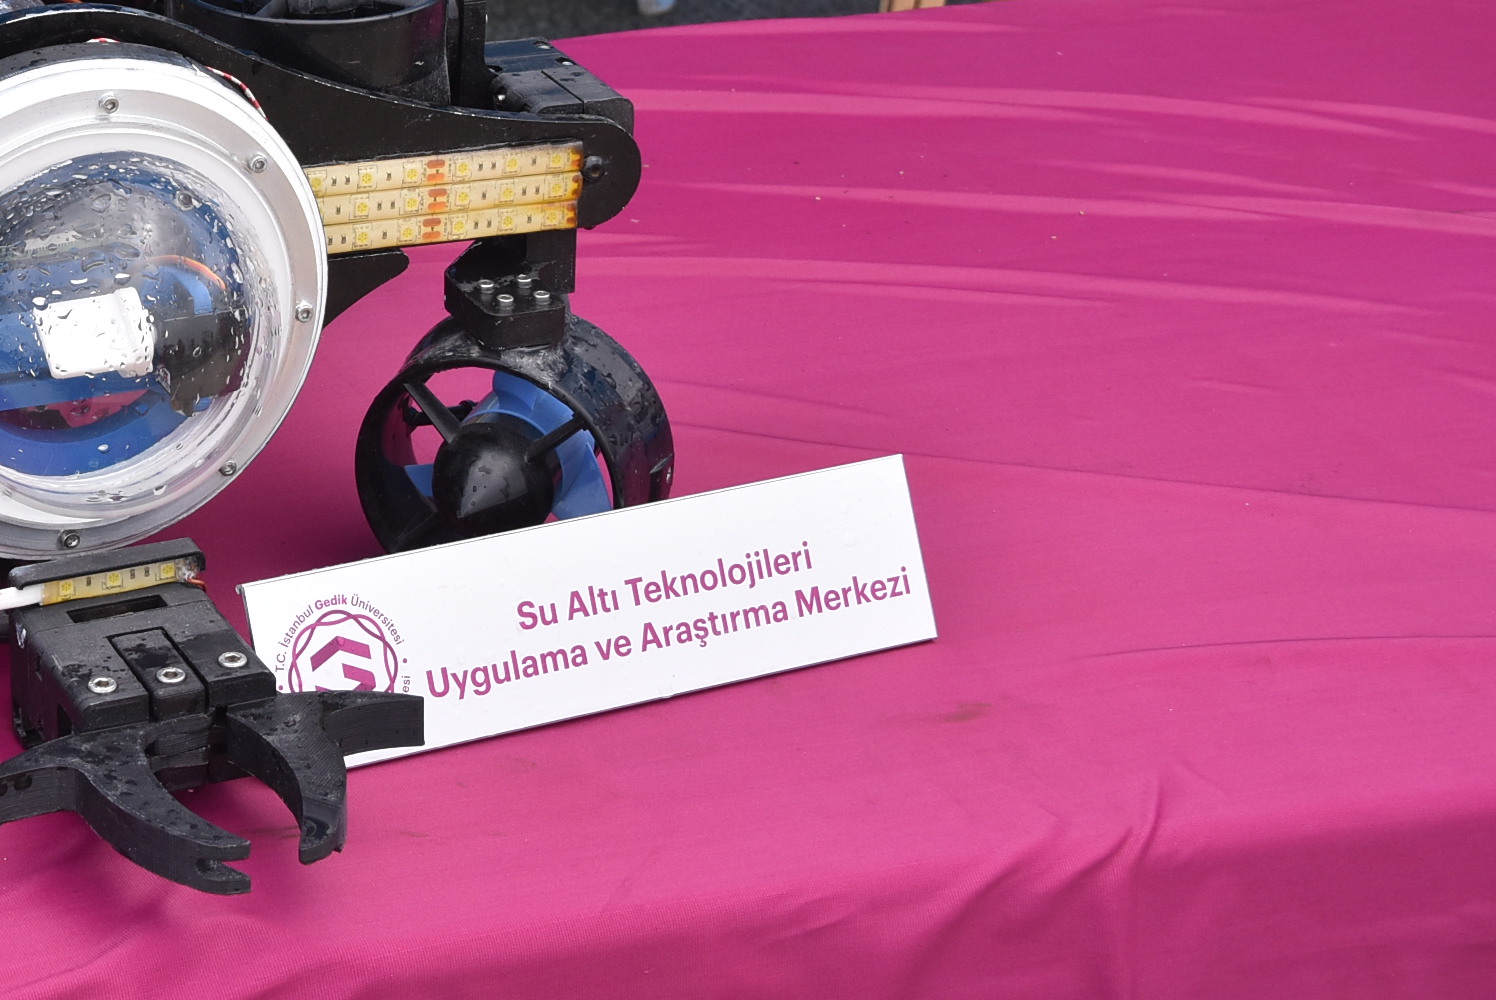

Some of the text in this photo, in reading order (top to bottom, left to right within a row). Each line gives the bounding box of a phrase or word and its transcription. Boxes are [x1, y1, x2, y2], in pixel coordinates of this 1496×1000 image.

[517, 541, 812, 630] Su Altı Teknolojileri
[275, 594, 404, 672] T.C. İstanbul Gedik Üniversitesi
[426, 566, 910, 700] Uygulama ve Araştırma Merkezi
